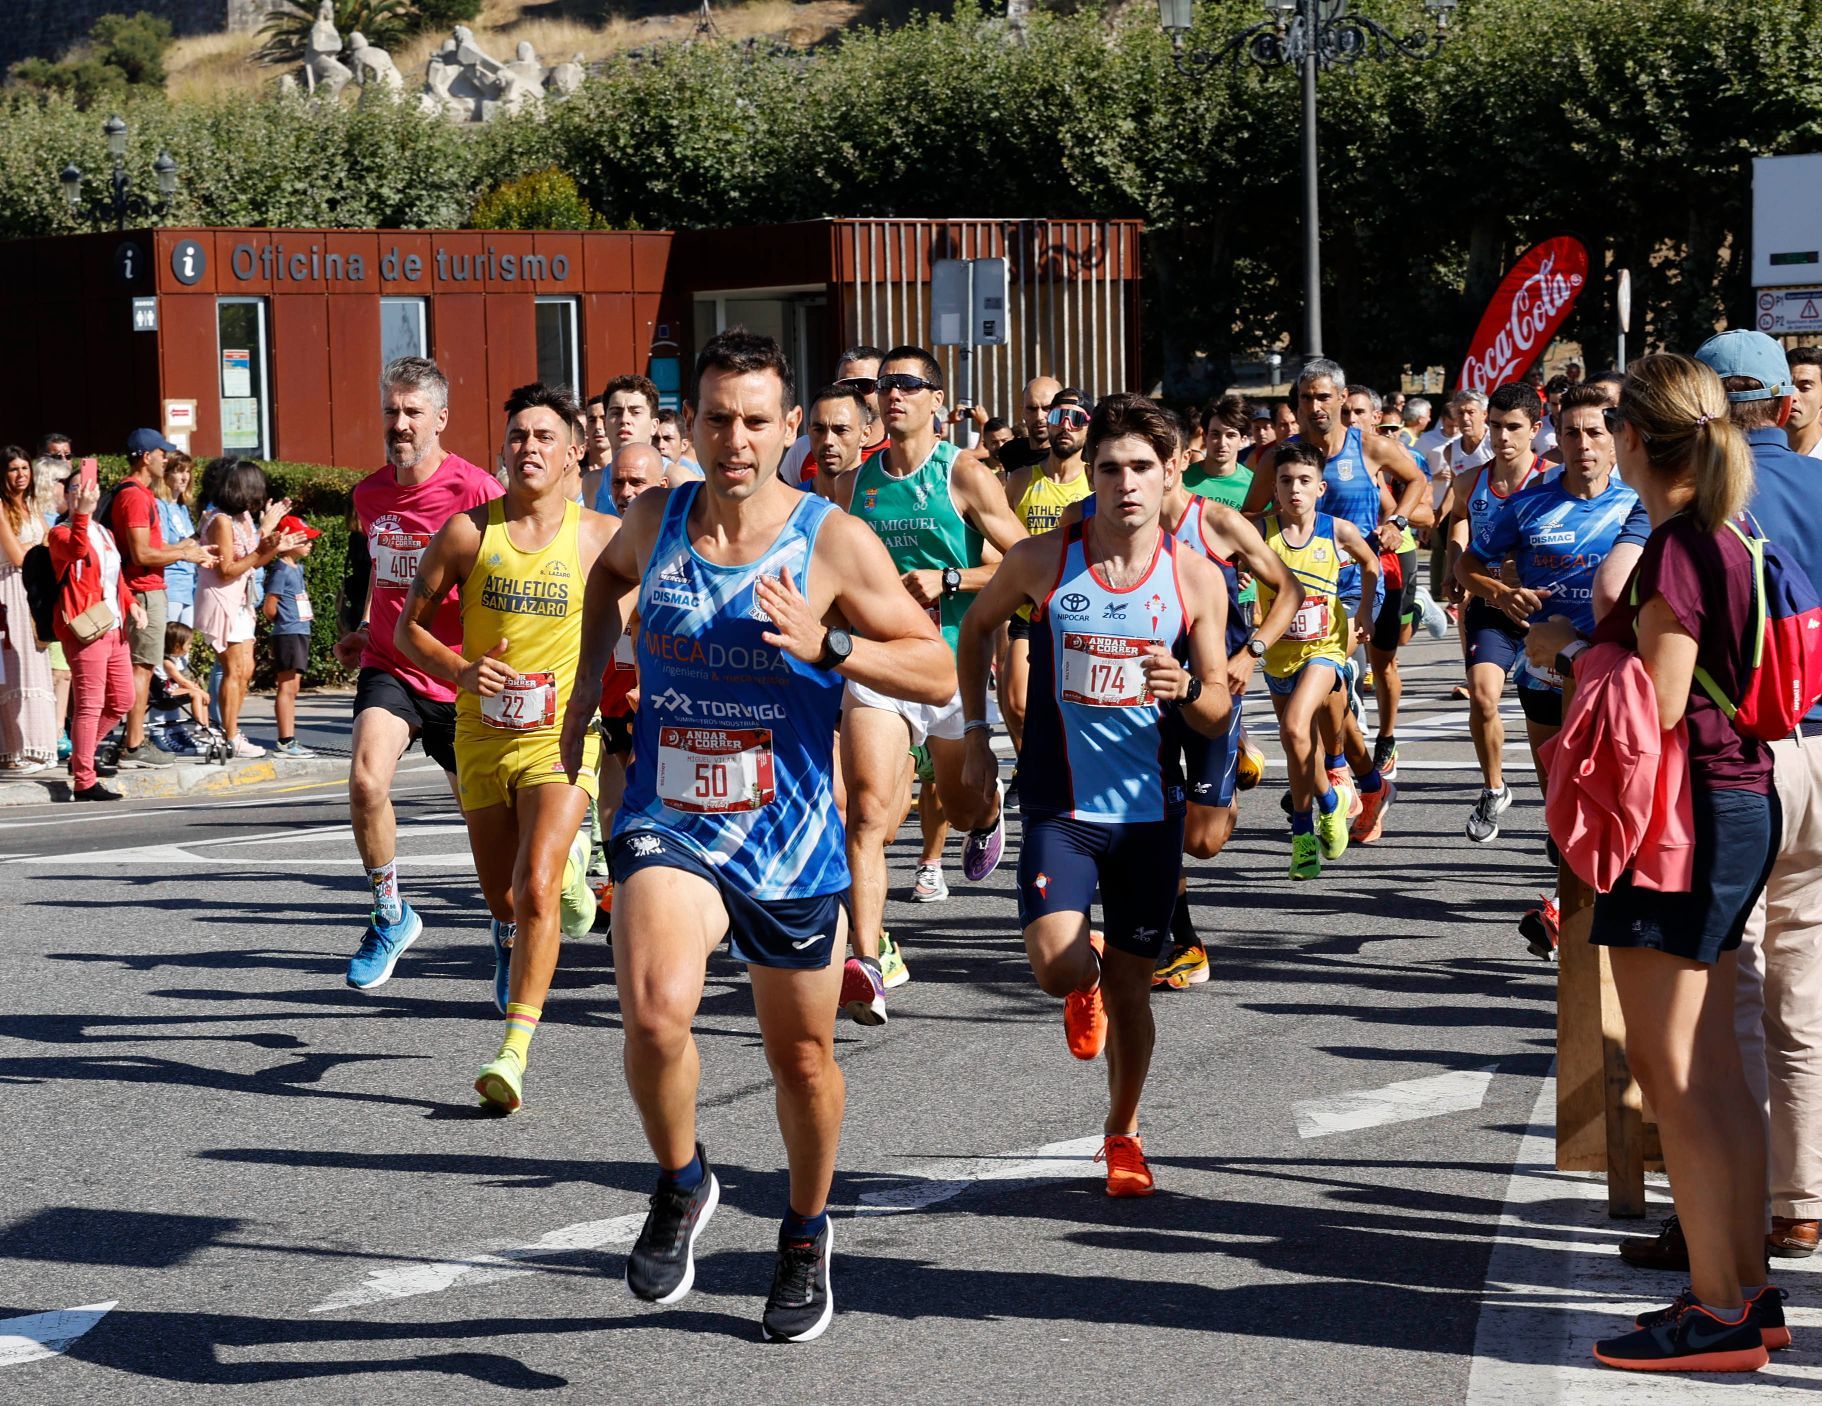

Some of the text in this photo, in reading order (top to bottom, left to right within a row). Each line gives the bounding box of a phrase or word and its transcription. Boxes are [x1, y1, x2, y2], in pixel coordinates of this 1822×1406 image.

[232, 244, 570, 281] Oficina de turismo
[1027, 505, 1065, 517] ATHLE
[881, 517, 938, 531] MIGUEL
[883, 532, 919, 547] ARÍN
[1531, 534, 1572, 545] DISMAC
[484, 575, 568, 600] ATHLETICS
[482, 594, 566, 616] SAN LÁZARO
[653, 590, 701, 608] DISMAC
[1057, 613, 1090, 621] NIPOCAR
[1089, 637, 1127, 647] ANDAR
[644, 630, 790, 674] MECADOBA
[1096, 645, 1139, 656] CORRER
[505, 679, 537, 687] ORRER
[1091, 664, 1126, 694] 174
[502, 695, 524, 719] 22
[696, 700, 787, 721] TORVIGO
[686, 731, 727, 740] ANDAR
[695, 739, 741, 749] CORRER
[695, 763, 728, 798] 50
